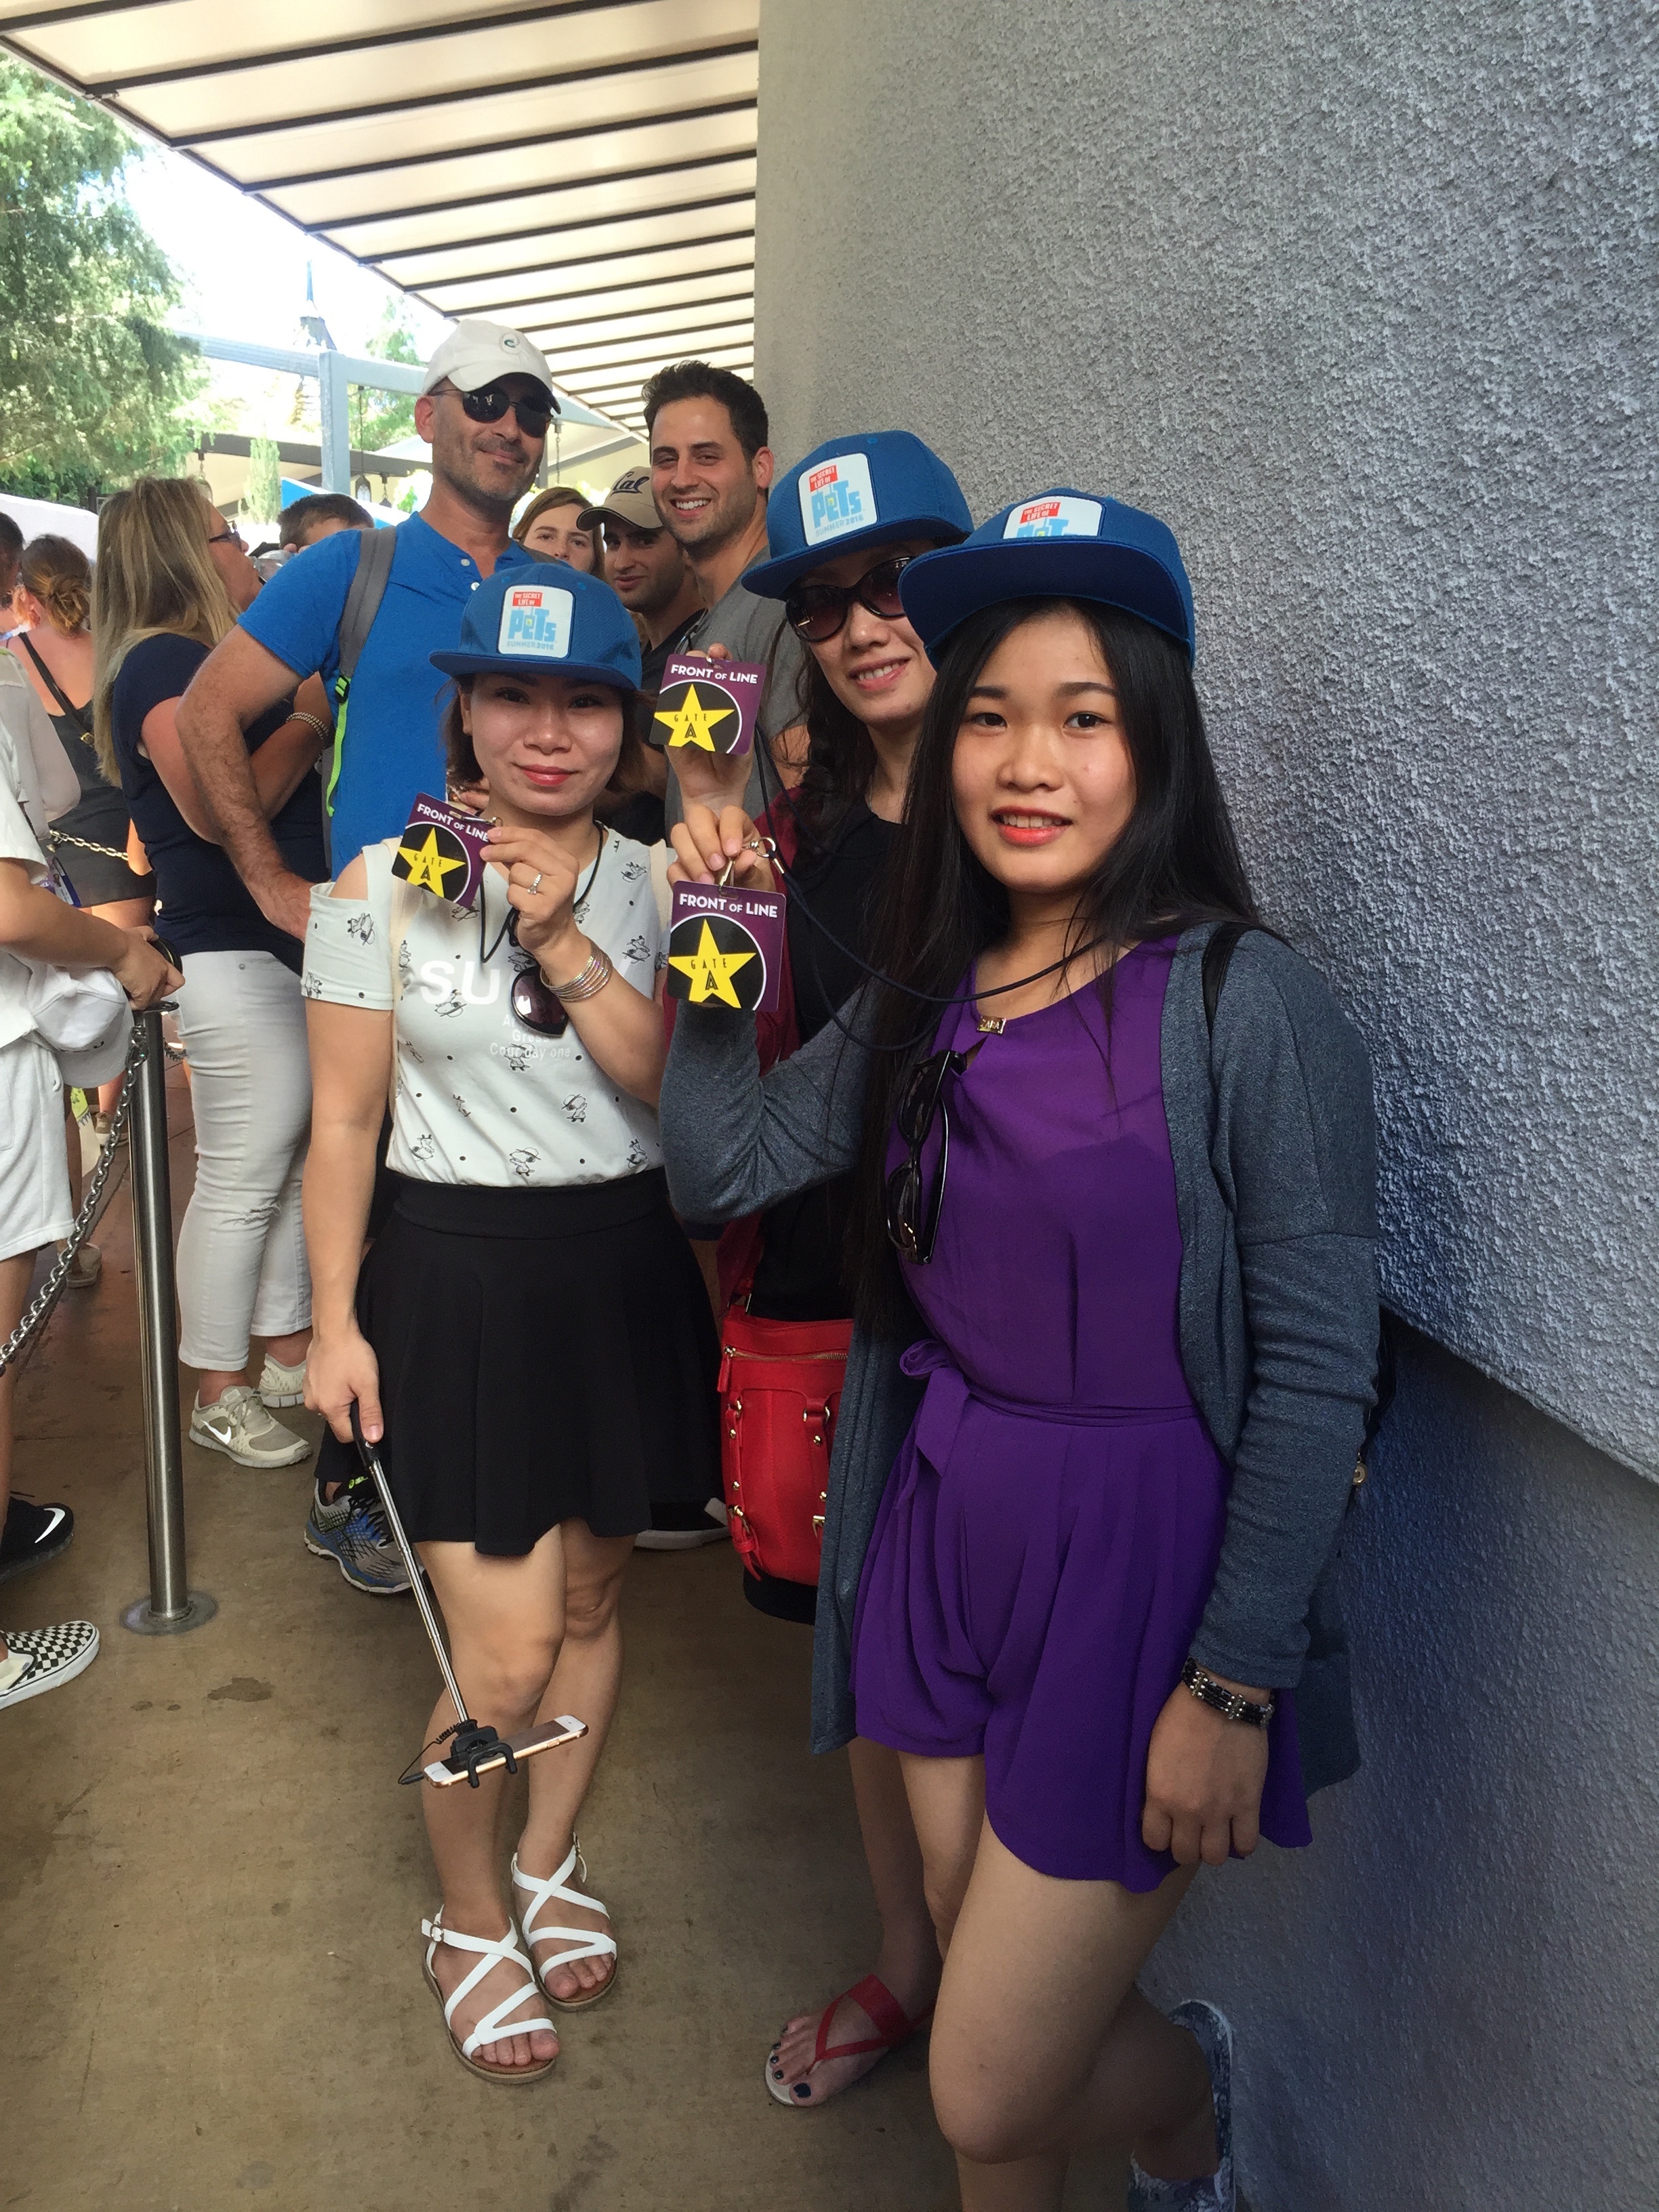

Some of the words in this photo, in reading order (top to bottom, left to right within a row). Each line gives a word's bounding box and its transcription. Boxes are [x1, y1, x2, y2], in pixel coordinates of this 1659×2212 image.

[610, 471, 650, 497] Cal
[1027, 512, 1042, 520] LIFE
[1033, 503, 1058, 513] SECRET
[670, 663, 714, 678] FRONT
[714, 672, 727, 680] OF
[729, 672, 758, 684] LINE
[674, 713, 708, 722] GATE
[684, 722, 697, 738] A
[417, 803, 454, 826] FRONT
[453, 822, 465, 830] OF
[466, 825, 489, 842] LINE
[414, 853, 442, 867] GATE
[420, 865, 431, 881] A
[679, 893, 727, 911] FRONT
[729, 903, 743, 913] OF
[746, 902, 778, 918] LINE
[691, 958, 727, 970] GATE
[705, 970, 719, 991] A
[550, 1047, 571, 1058] one
